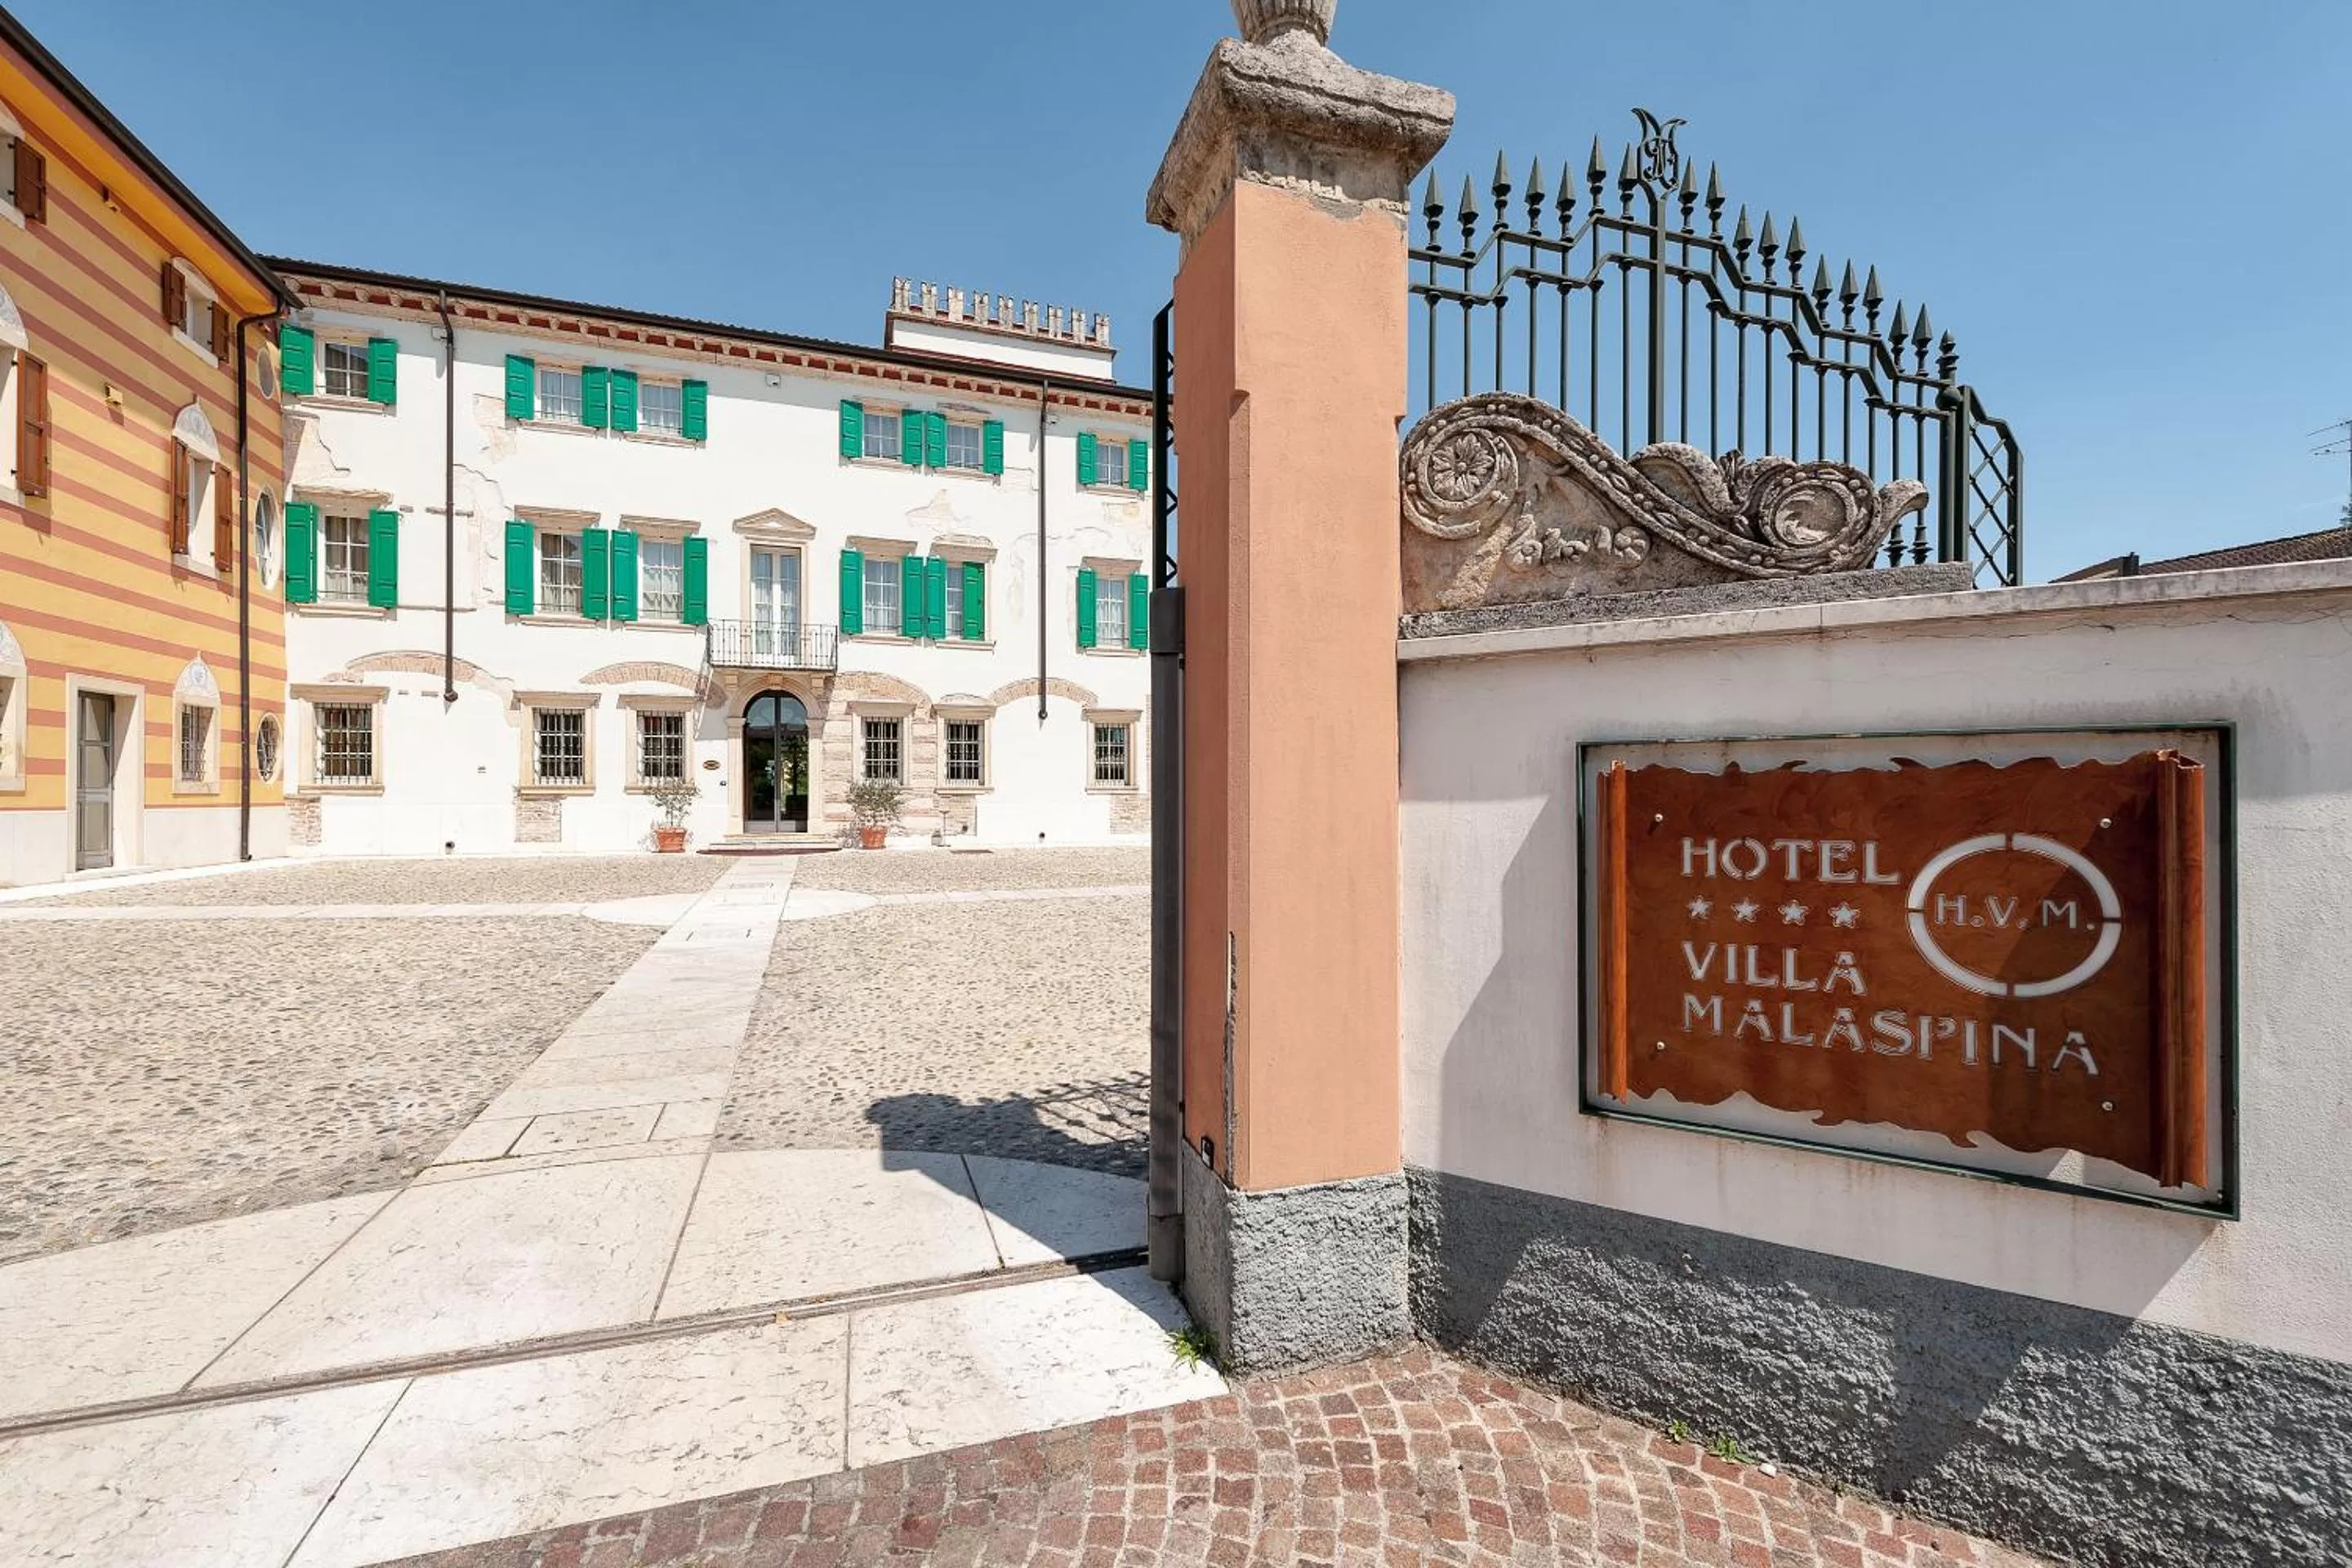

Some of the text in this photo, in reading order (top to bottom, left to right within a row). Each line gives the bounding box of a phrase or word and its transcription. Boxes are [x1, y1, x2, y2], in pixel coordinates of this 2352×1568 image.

[1681, 836, 1901, 884] HOTEL
[1681, 940, 1868, 996] VILLA
[1681, 992, 2100, 1076] MALASPINA
